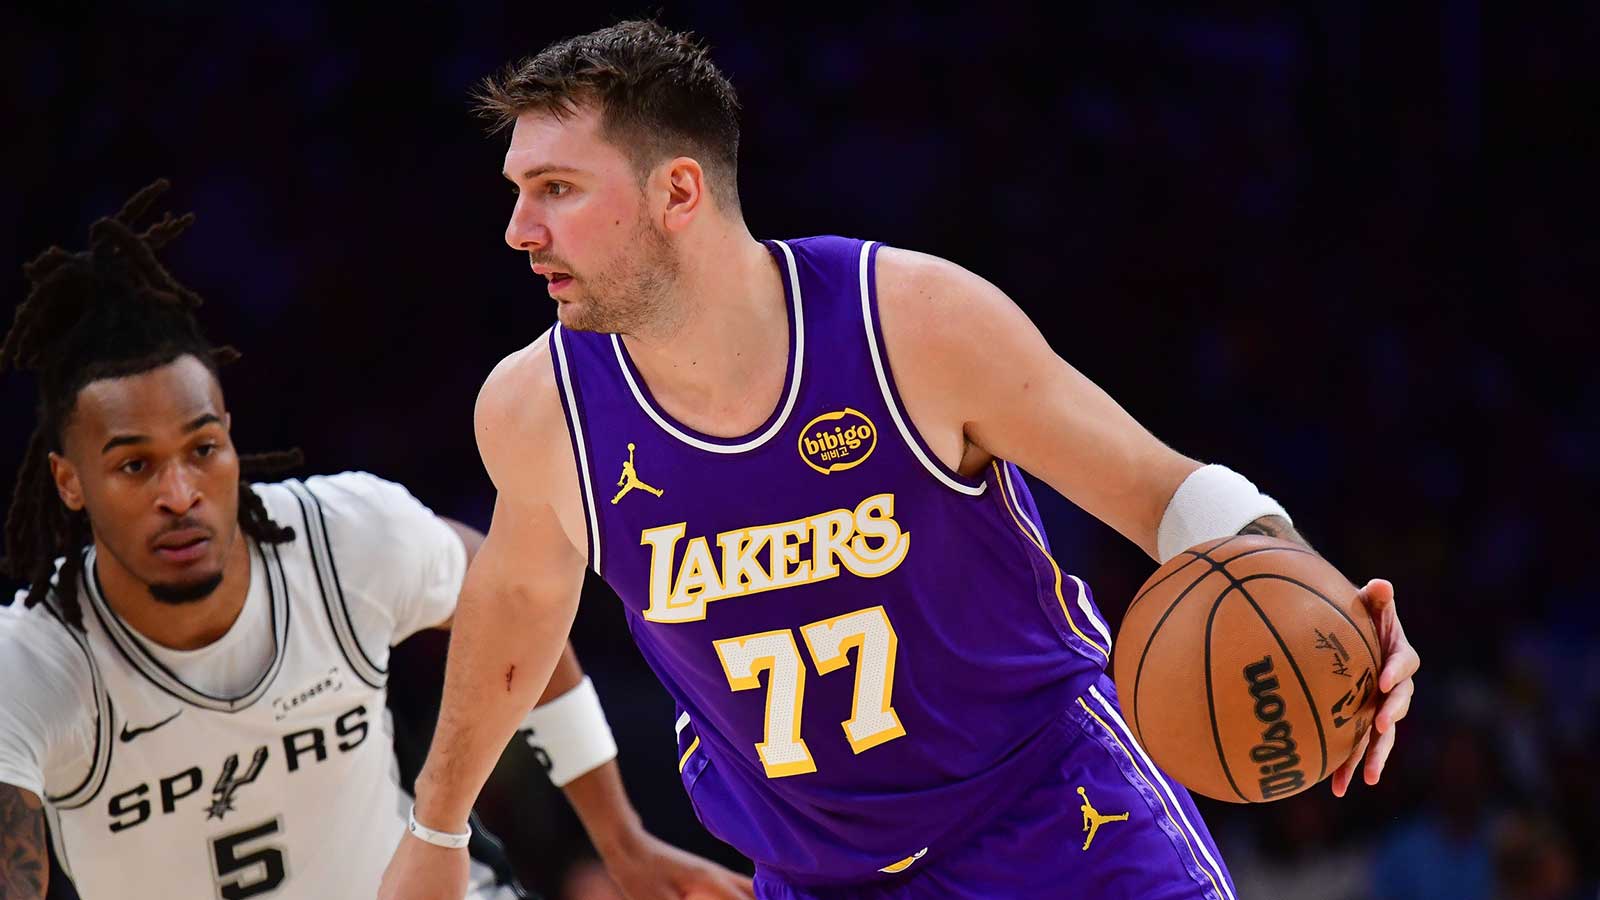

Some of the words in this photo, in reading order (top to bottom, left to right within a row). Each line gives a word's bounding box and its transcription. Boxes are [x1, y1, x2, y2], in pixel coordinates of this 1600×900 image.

[804, 425, 871, 455] bibigo
[820, 446, 849, 461] 비비고
[640, 493, 910, 623] LAKERS
[712, 605, 907, 779] 77
[1243, 654, 1306, 800] Wilson
[108, 705, 369, 833] SPURS
[210, 817, 287, 900] 5
